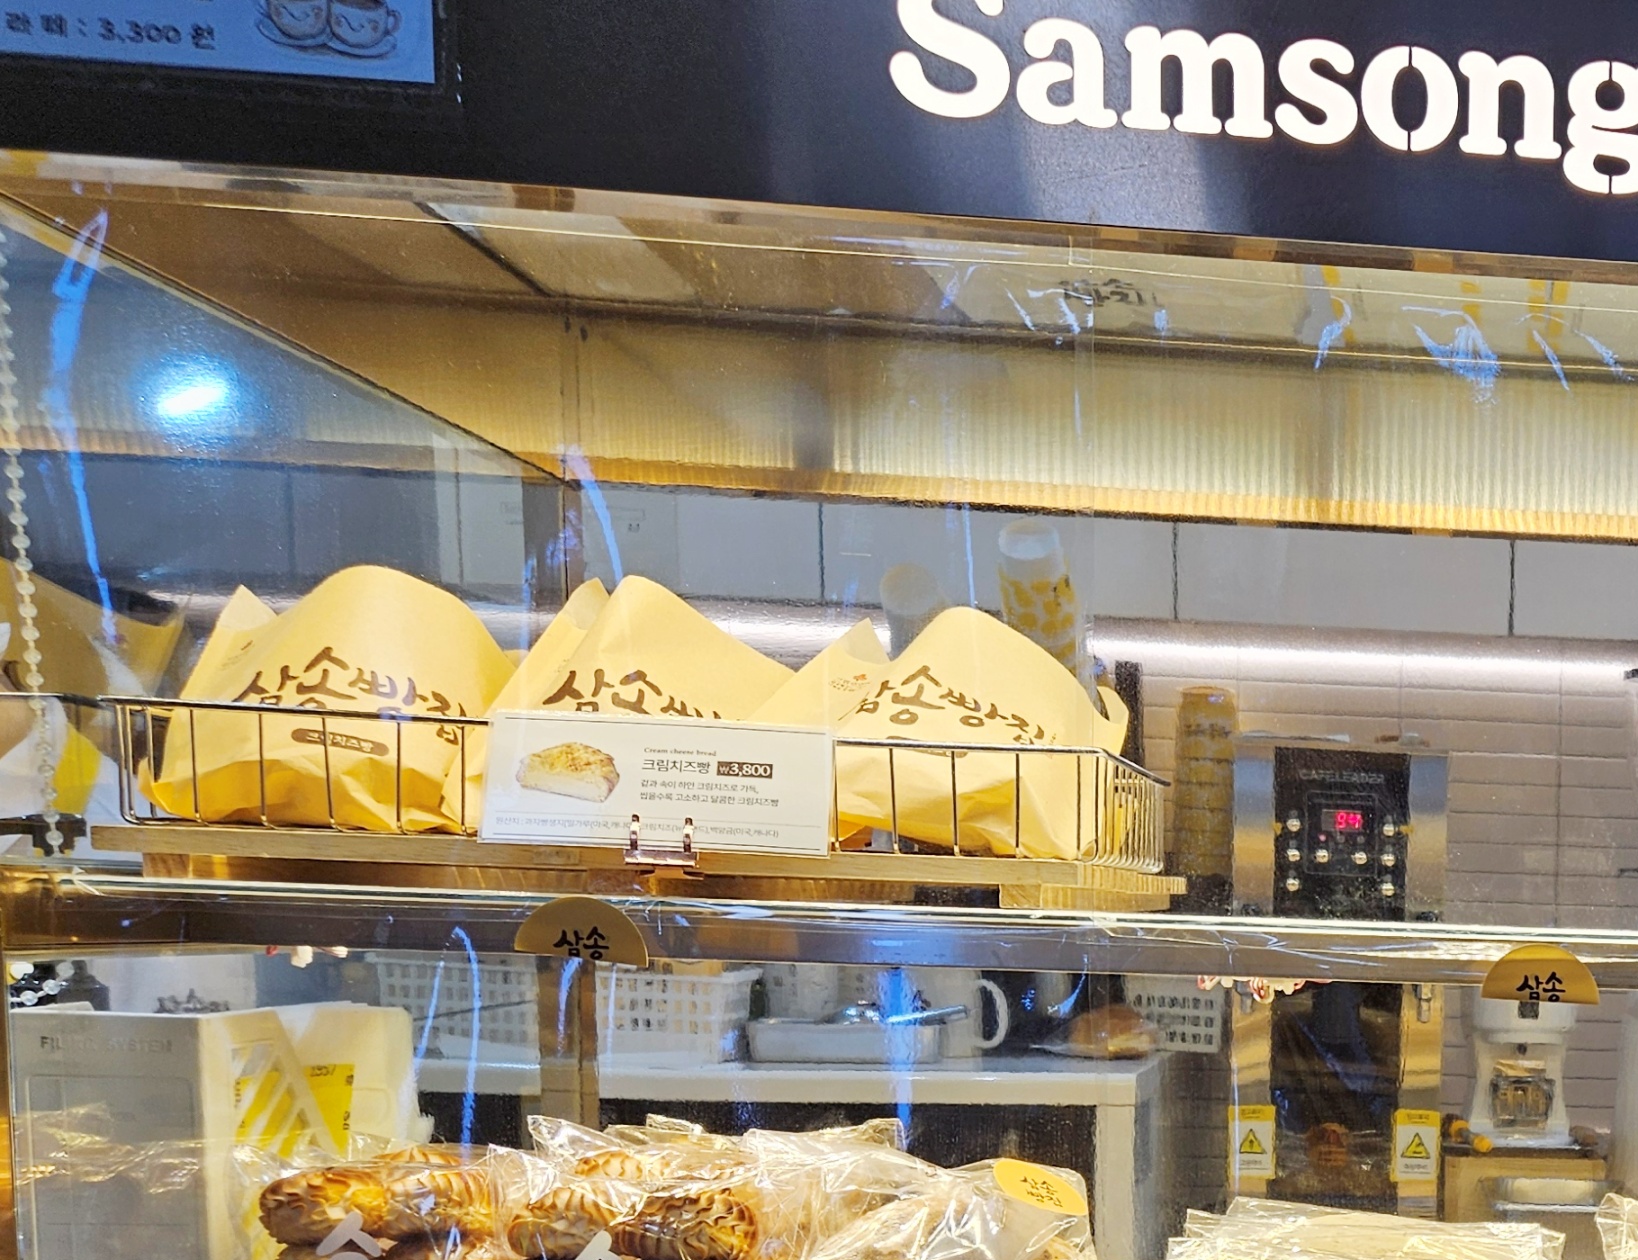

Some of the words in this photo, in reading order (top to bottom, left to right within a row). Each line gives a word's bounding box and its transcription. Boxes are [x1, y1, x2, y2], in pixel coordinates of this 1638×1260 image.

[98, 17, 182, 44] 3,300
[642, 759, 710, 774] 크림치즈빵
[719, 763, 770, 776] ₩3,800
[553, 924, 609, 960] 삼송
[1517, 970, 1566, 1002] 삼송
